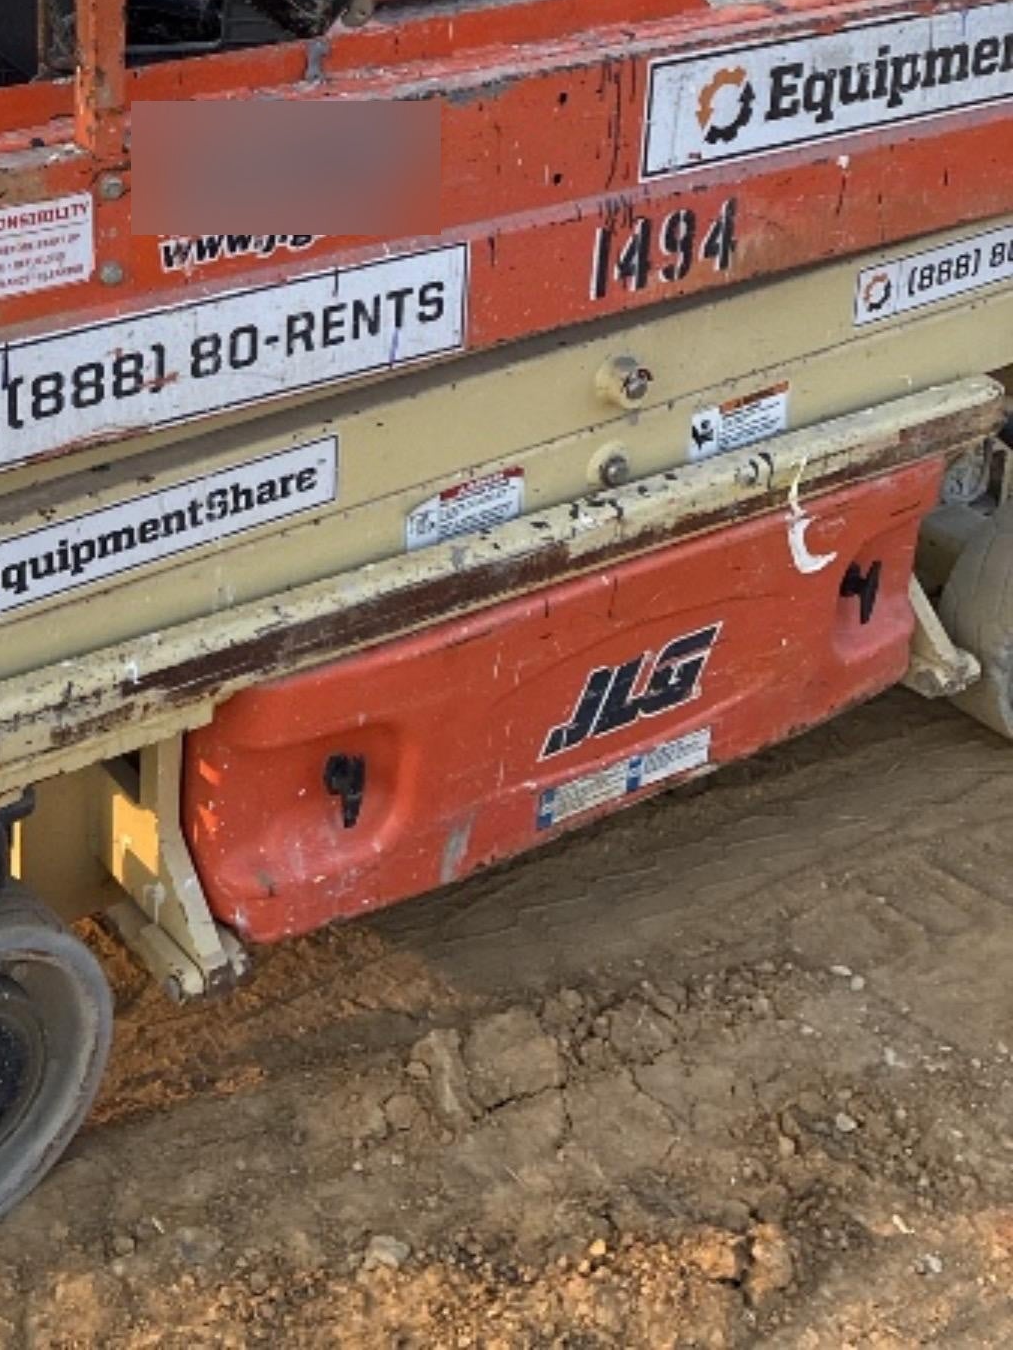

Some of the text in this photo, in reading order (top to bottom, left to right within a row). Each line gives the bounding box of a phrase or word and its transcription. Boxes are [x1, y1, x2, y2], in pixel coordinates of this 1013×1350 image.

[590, 198, 737, 301] 1494
[191, 280, 445, 379] 80-RENTS
[537, 621, 724, 760] JLG
